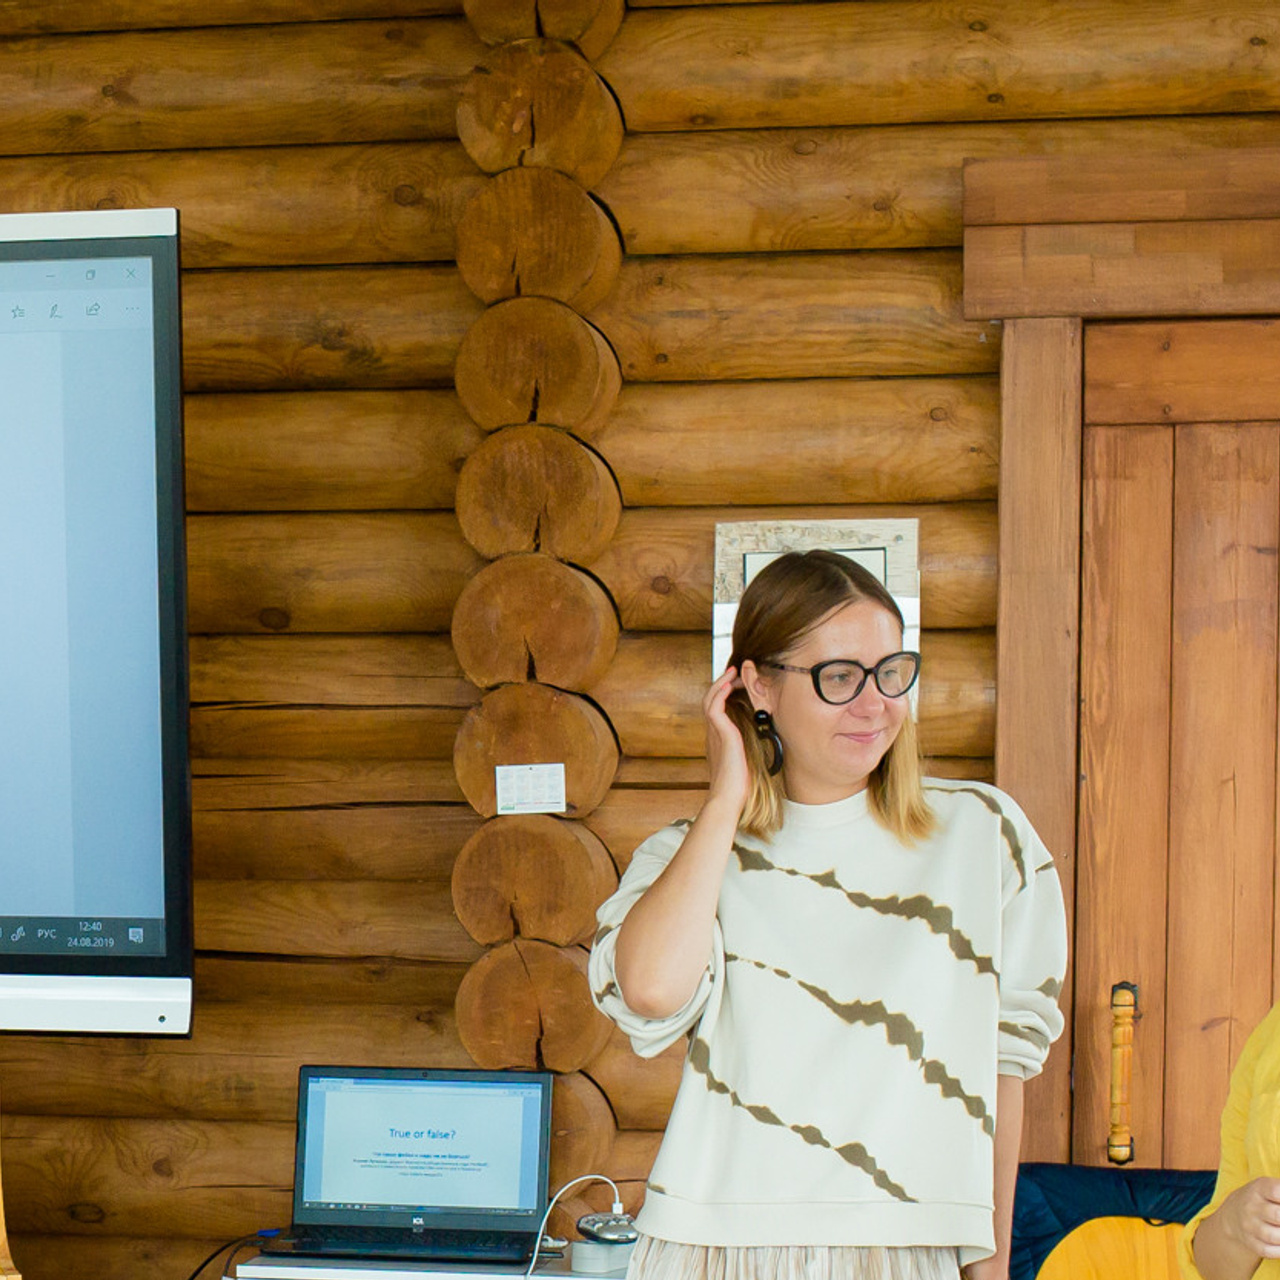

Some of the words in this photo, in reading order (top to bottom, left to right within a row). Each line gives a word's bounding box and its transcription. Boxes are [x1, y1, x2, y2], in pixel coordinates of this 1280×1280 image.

[78, 921, 103, 932] 12:40
[37, 928, 57, 940] РУС
[67, 936, 115, 948] 24.08.2019
[389, 1128, 411, 1139] True
[413, 1130, 424, 1139] or
[427, 1128, 457, 1140] false?
